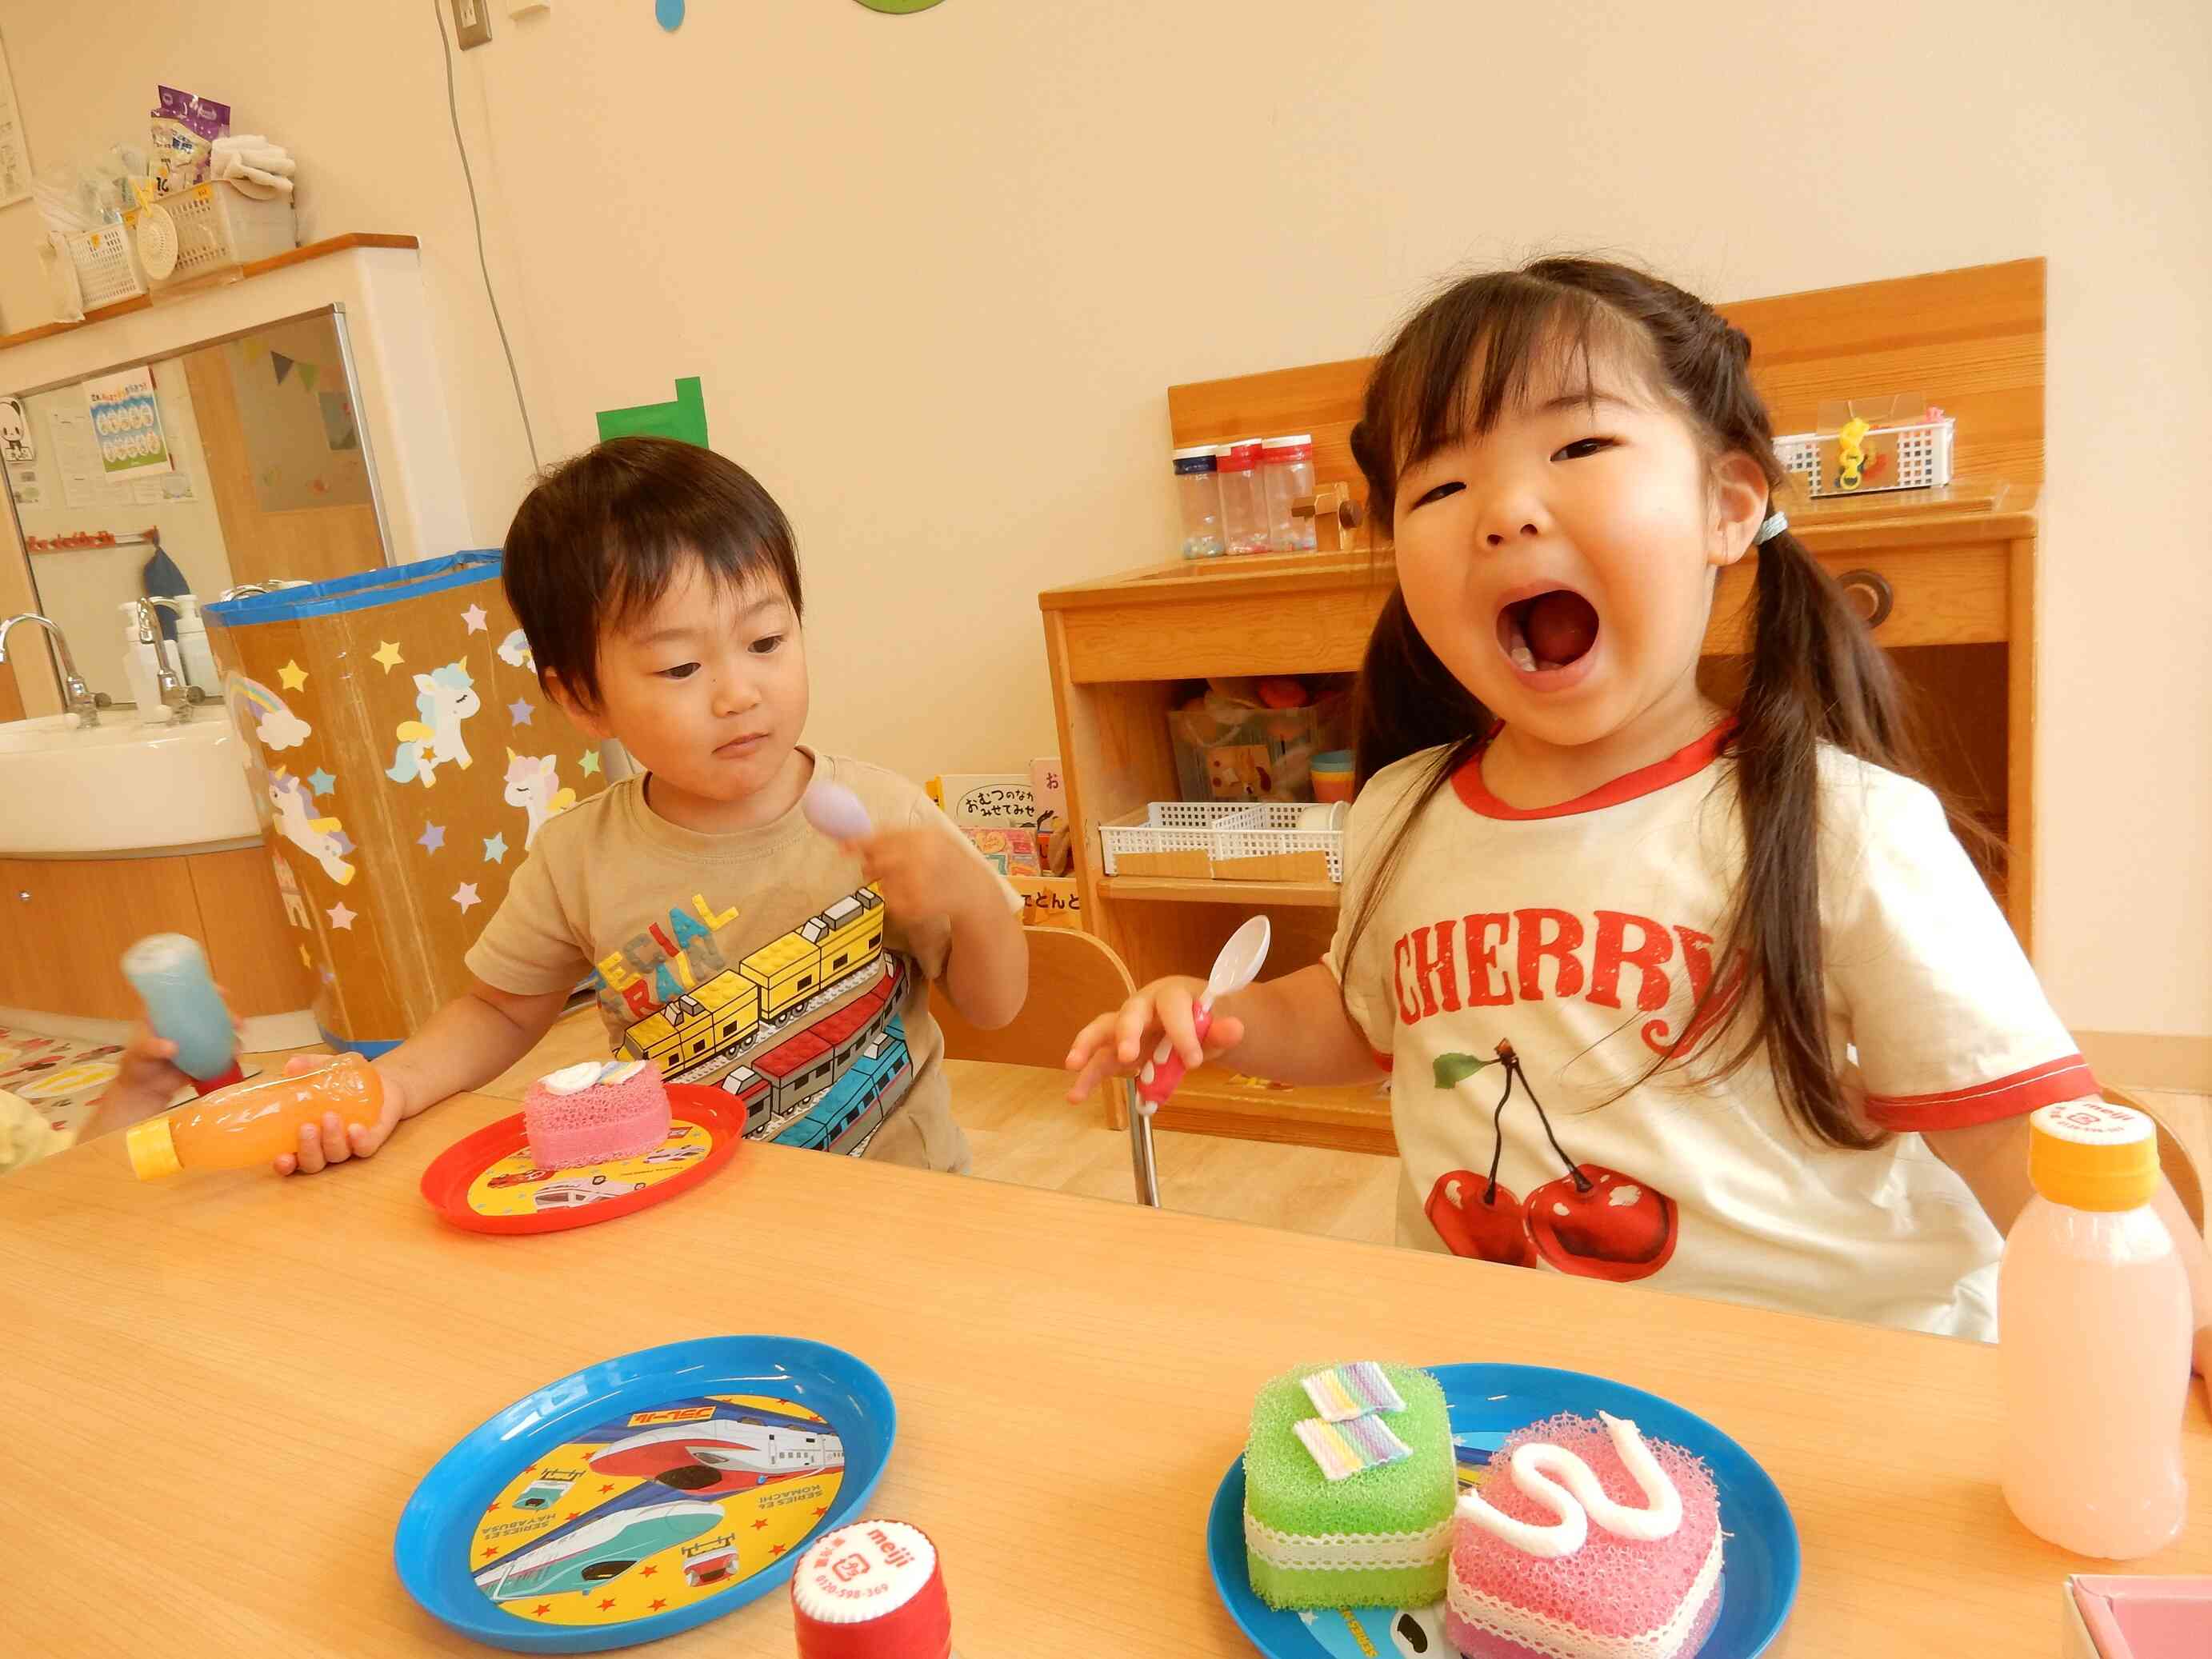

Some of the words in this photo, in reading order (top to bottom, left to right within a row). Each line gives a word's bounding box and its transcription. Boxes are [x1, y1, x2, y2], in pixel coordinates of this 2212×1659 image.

[1046, 772, 1059, 790] お
[981, 804, 1034, 817] みせてみせ
[597, 893, 739, 992] ECIAL
[1394, 908, 1752, 1059] CHERRY
[759, 1485, 821, 1503] KOMACHI
[777, 1490, 822, 1505] SERIES
[482, 1513, 555, 1532] HAYABUSA
[866, 1529, 915, 1568] meiji
